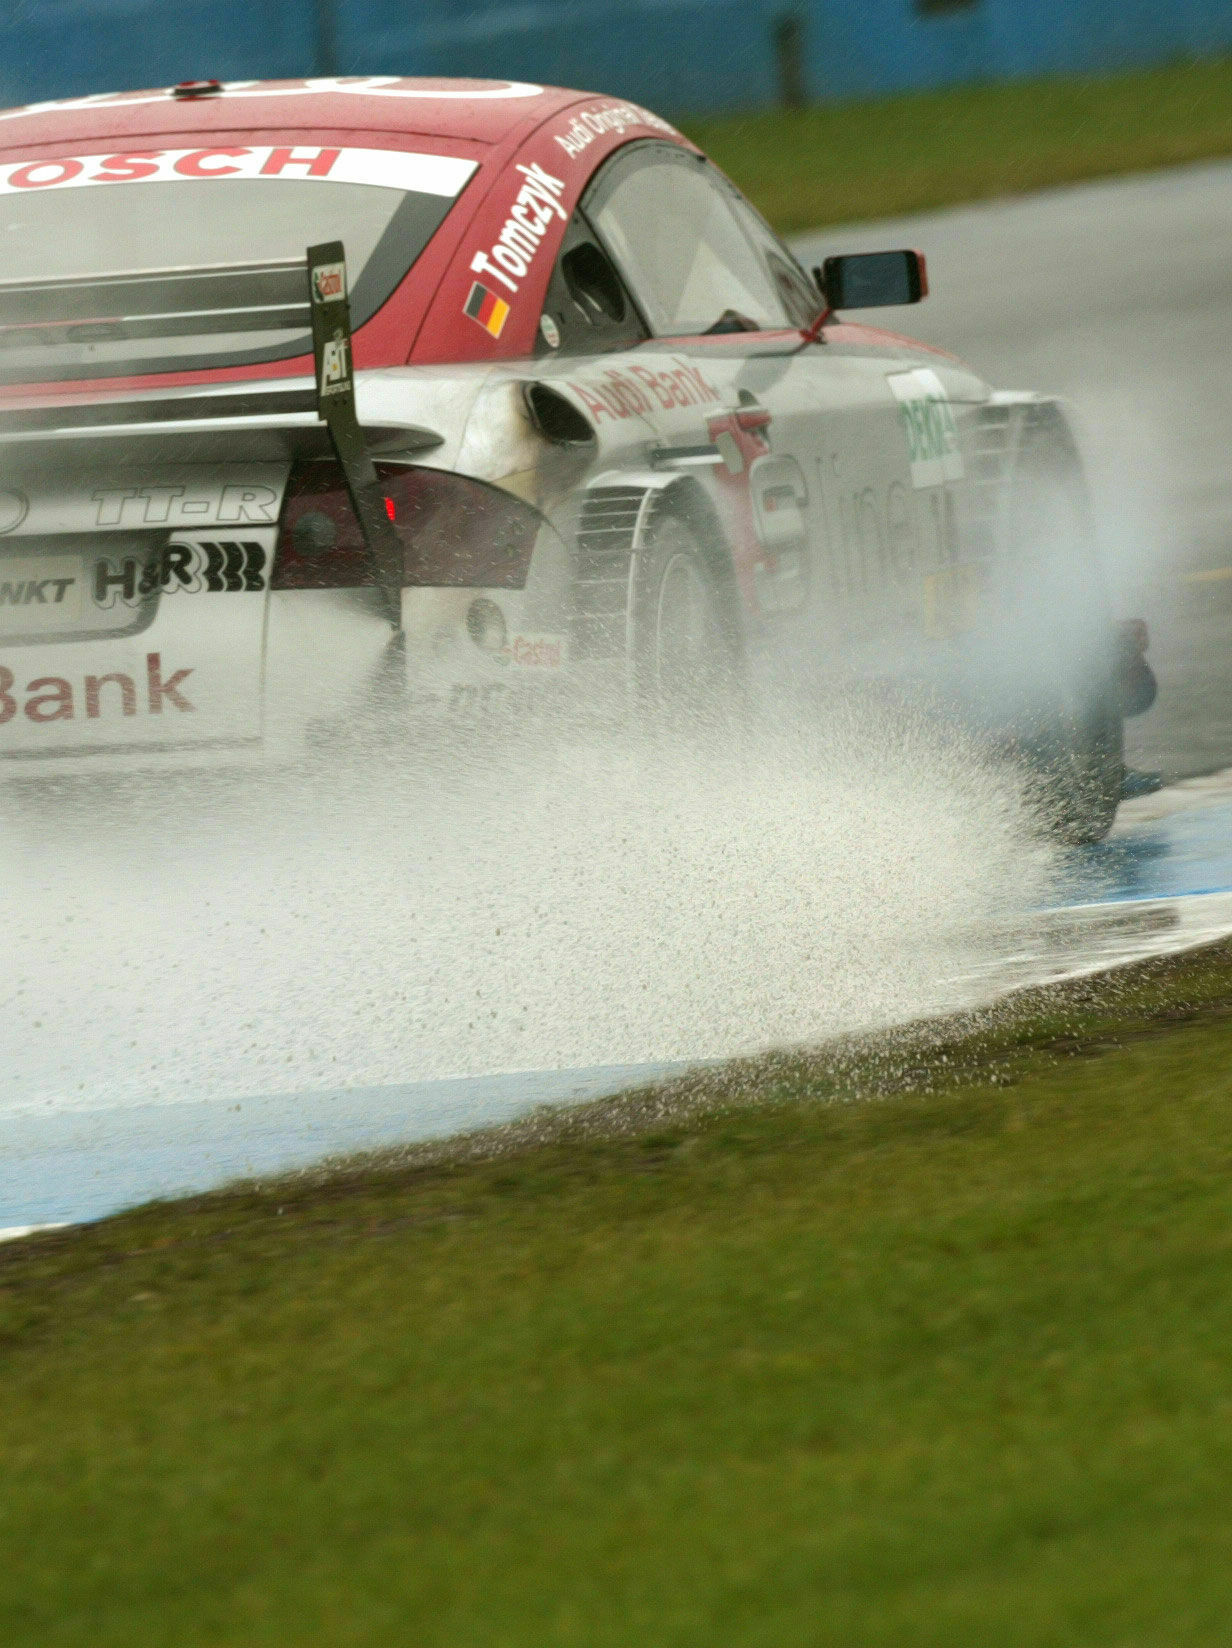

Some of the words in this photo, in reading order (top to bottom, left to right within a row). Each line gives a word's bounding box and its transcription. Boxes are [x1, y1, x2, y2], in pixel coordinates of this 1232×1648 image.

[554, 117, 596, 160] Audi
[470, 160, 567, 293] Tomczyk
[569, 364, 647, 425] Audi
[638, 357, 720, 412] Bank
[91, 484, 277, 526] TT-R
[94, 541, 204, 611] H&R
